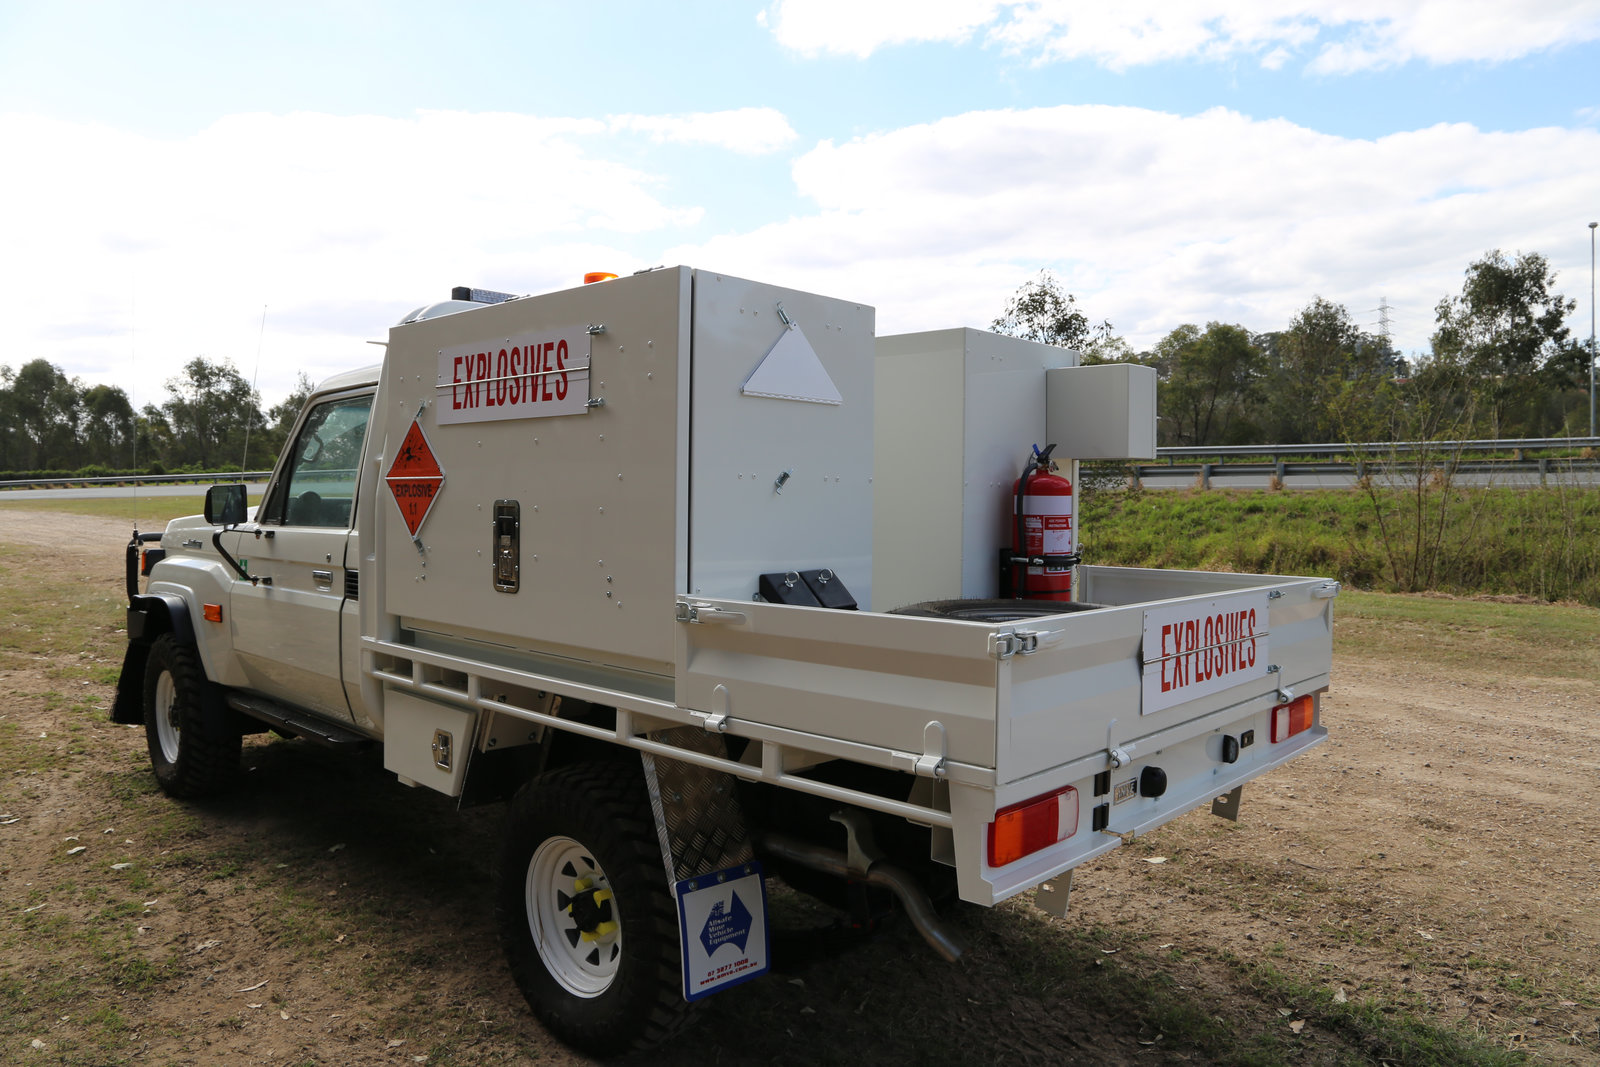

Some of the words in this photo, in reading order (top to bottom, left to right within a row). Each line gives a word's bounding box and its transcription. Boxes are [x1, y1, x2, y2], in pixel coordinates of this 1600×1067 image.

[452, 339, 569, 410] EXPLOSIVES
[395, 484, 432, 497] EXPLOSIVE
[1161, 608, 1256, 693] EXPLOSIVES
[708, 916, 733, 927] Allsafe
[708, 924, 725, 933] Mine
[708, 927, 734, 939] Vehicle
[709, 929, 746, 945] Equipment
